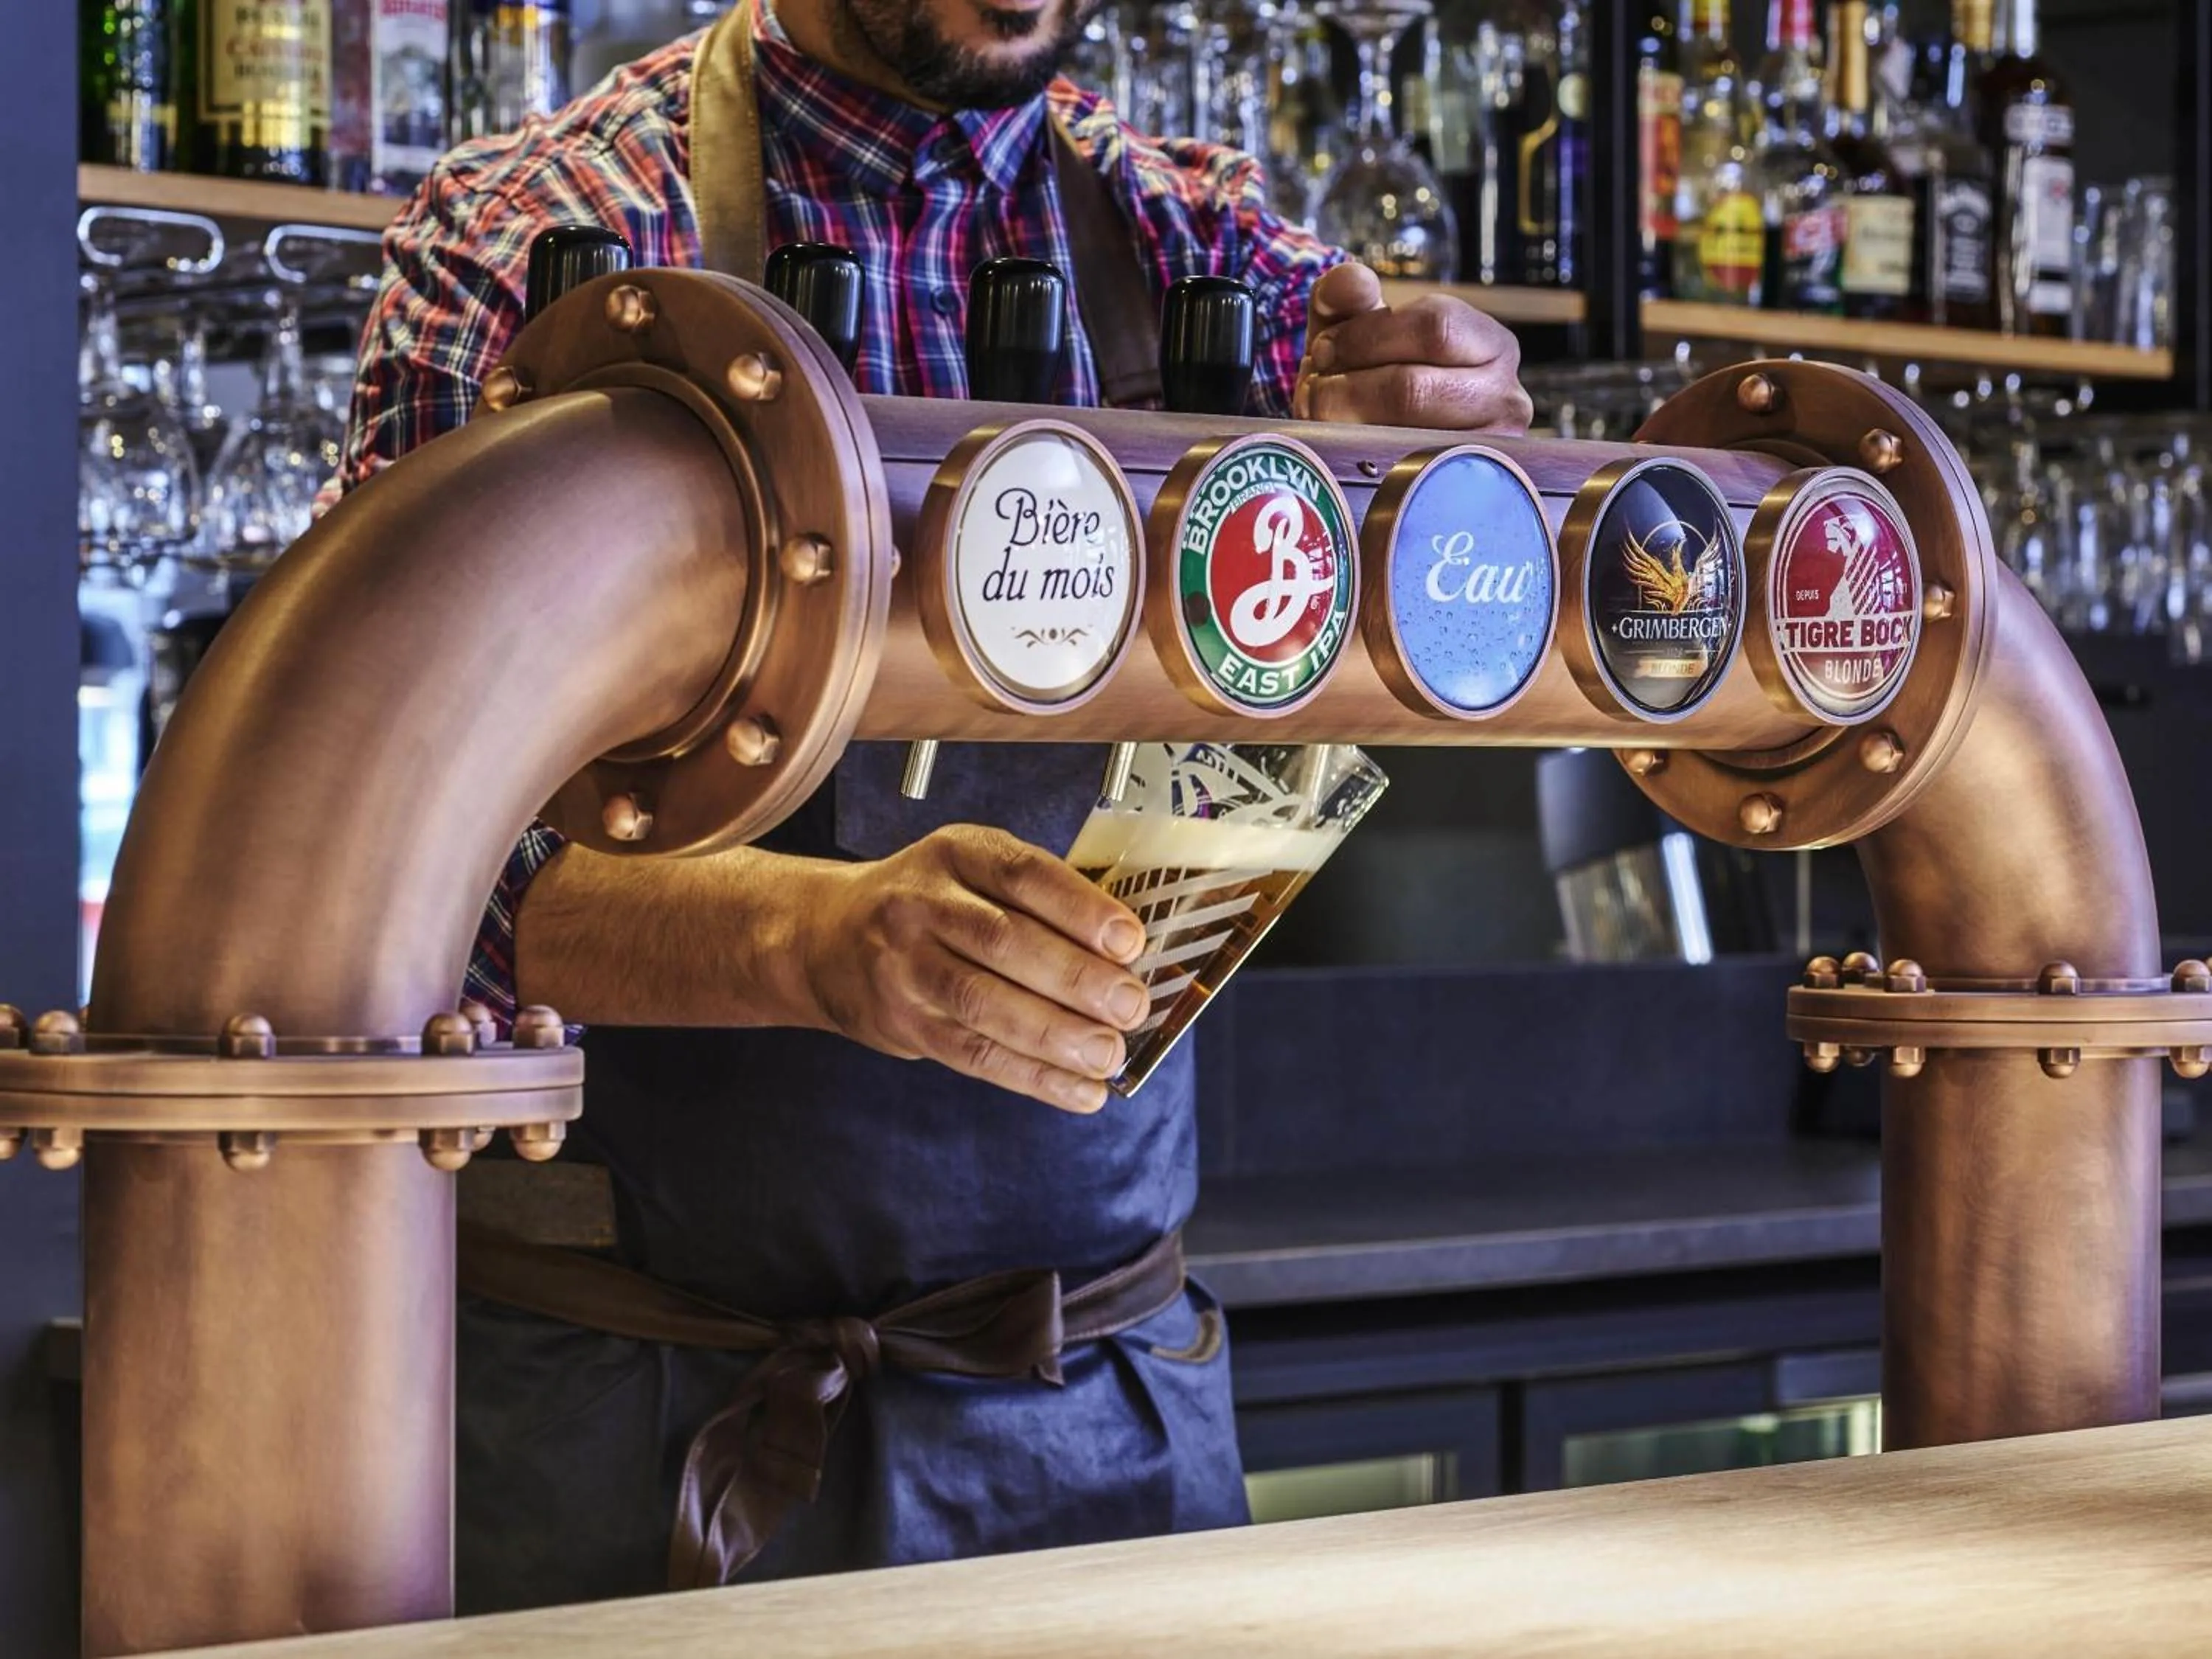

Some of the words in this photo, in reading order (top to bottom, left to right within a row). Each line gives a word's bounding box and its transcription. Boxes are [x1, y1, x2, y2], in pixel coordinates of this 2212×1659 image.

[995, 487, 1100, 546] Bière
[1188, 456, 1320, 555] BROOKLYN
[983, 546, 1028, 601] du
[1039, 553, 1115, 600] mois
[1426, 531, 1532, 603] Eau
[1218, 653, 1300, 695] EAST
[1310, 611, 1346, 672] IPA
[1618, 616, 1728, 639] GRIMBERGEN
[1785, 620, 1854, 648] TIGRE
[1860, 615, 1913, 647] BOCK
